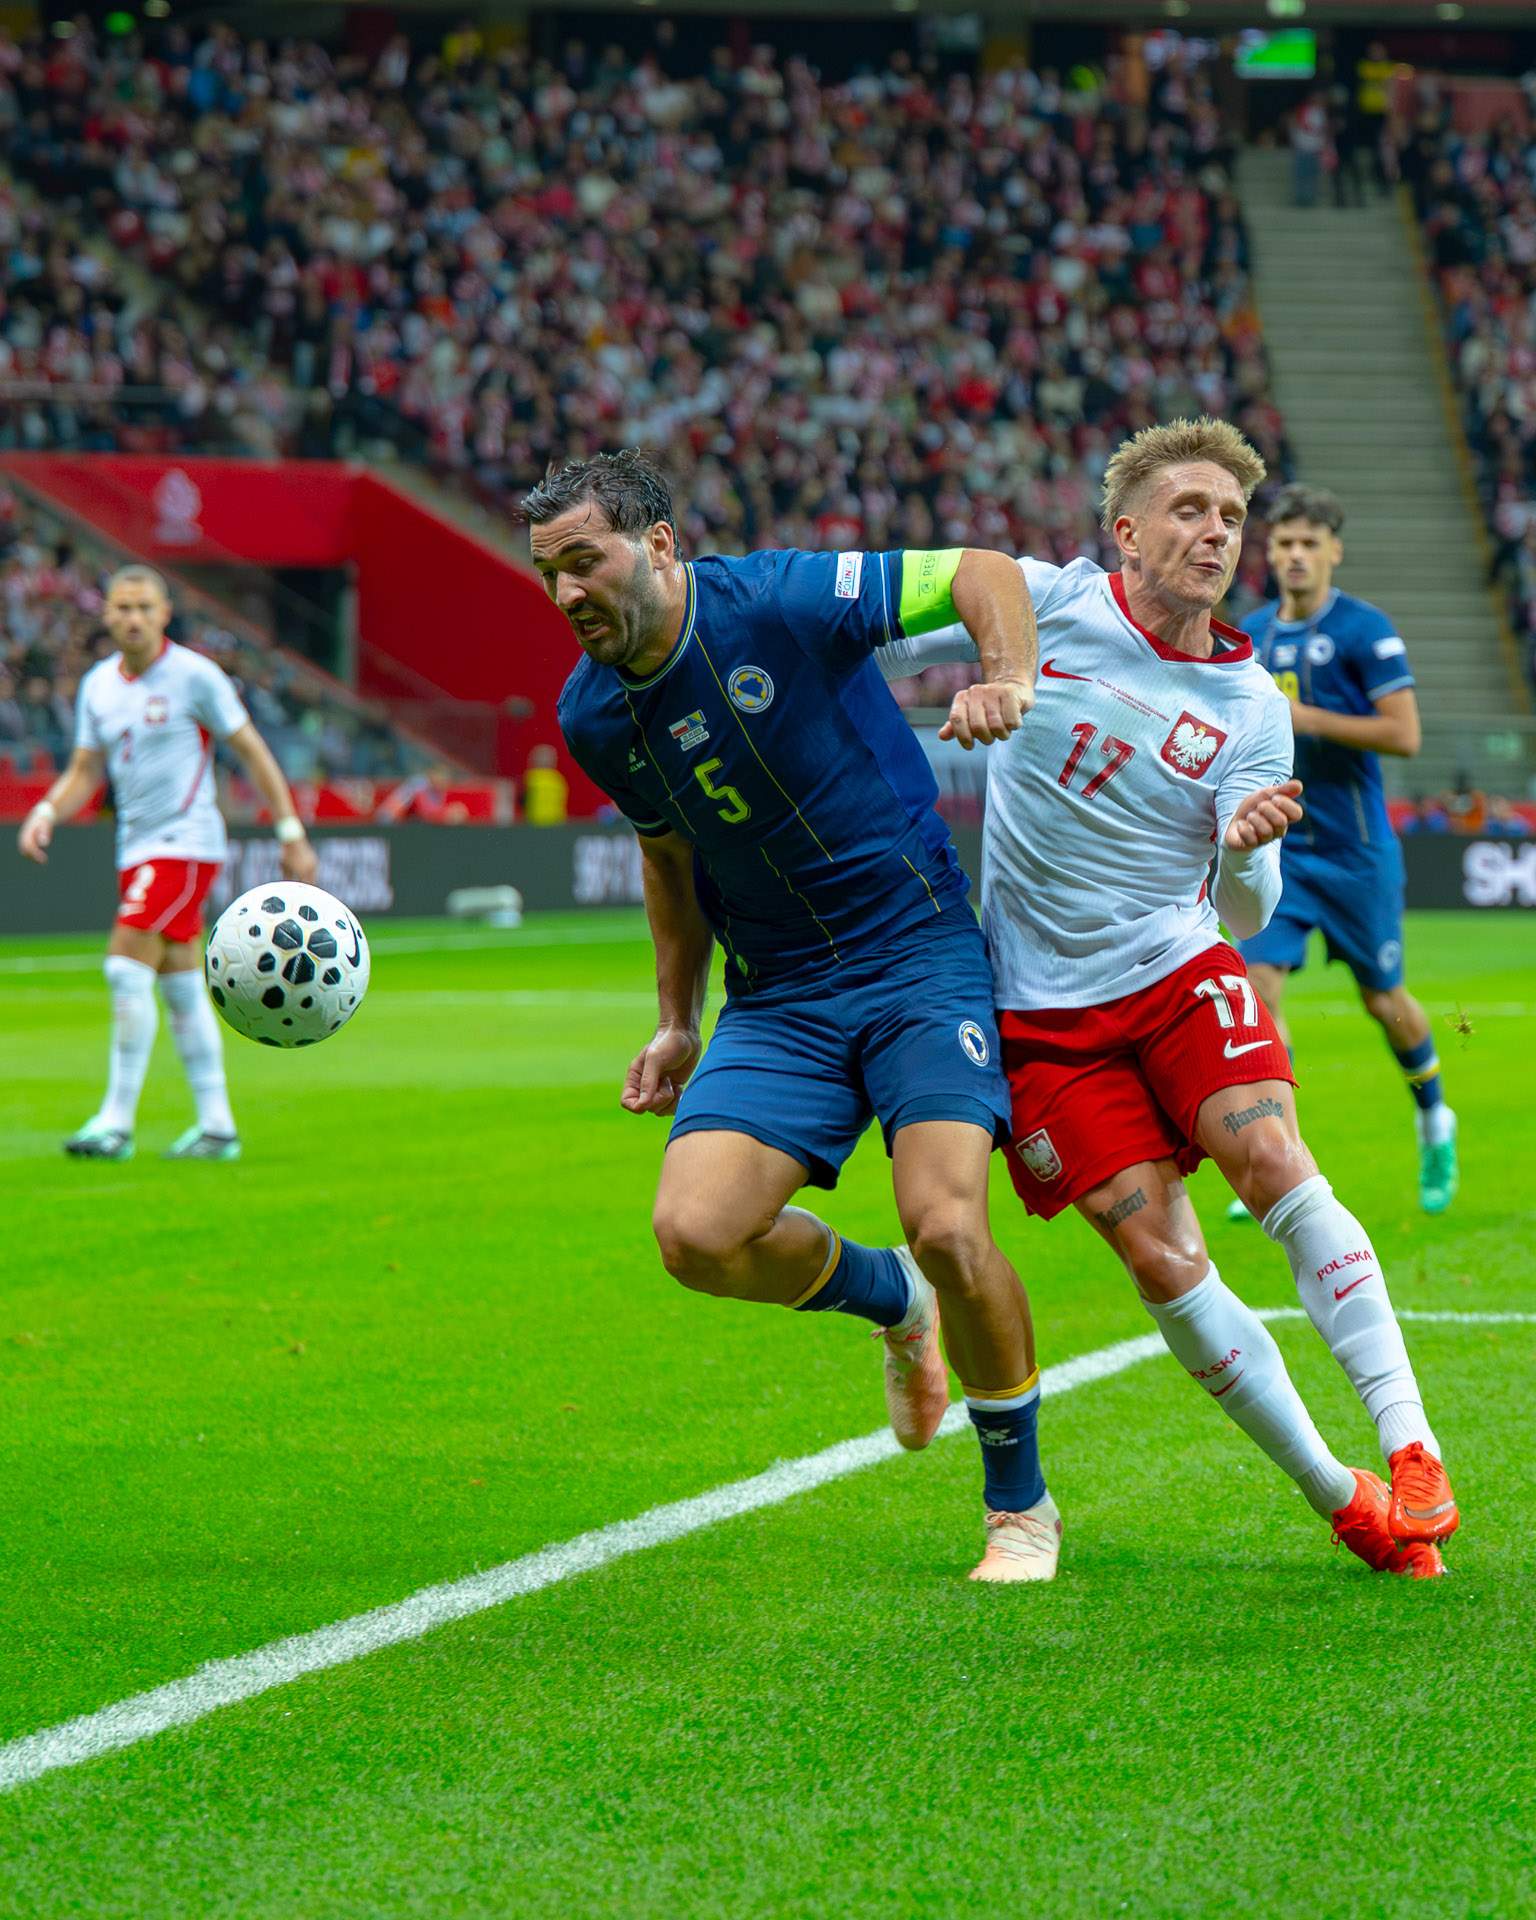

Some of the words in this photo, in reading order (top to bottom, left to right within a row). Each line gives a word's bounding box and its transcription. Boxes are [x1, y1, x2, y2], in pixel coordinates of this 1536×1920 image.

[694, 757, 752, 824] 5
[1058, 722, 1136, 800] 17
[1193, 975, 1259, 1029] 17
[1316, 1249, 1373, 1282] POLSKA
